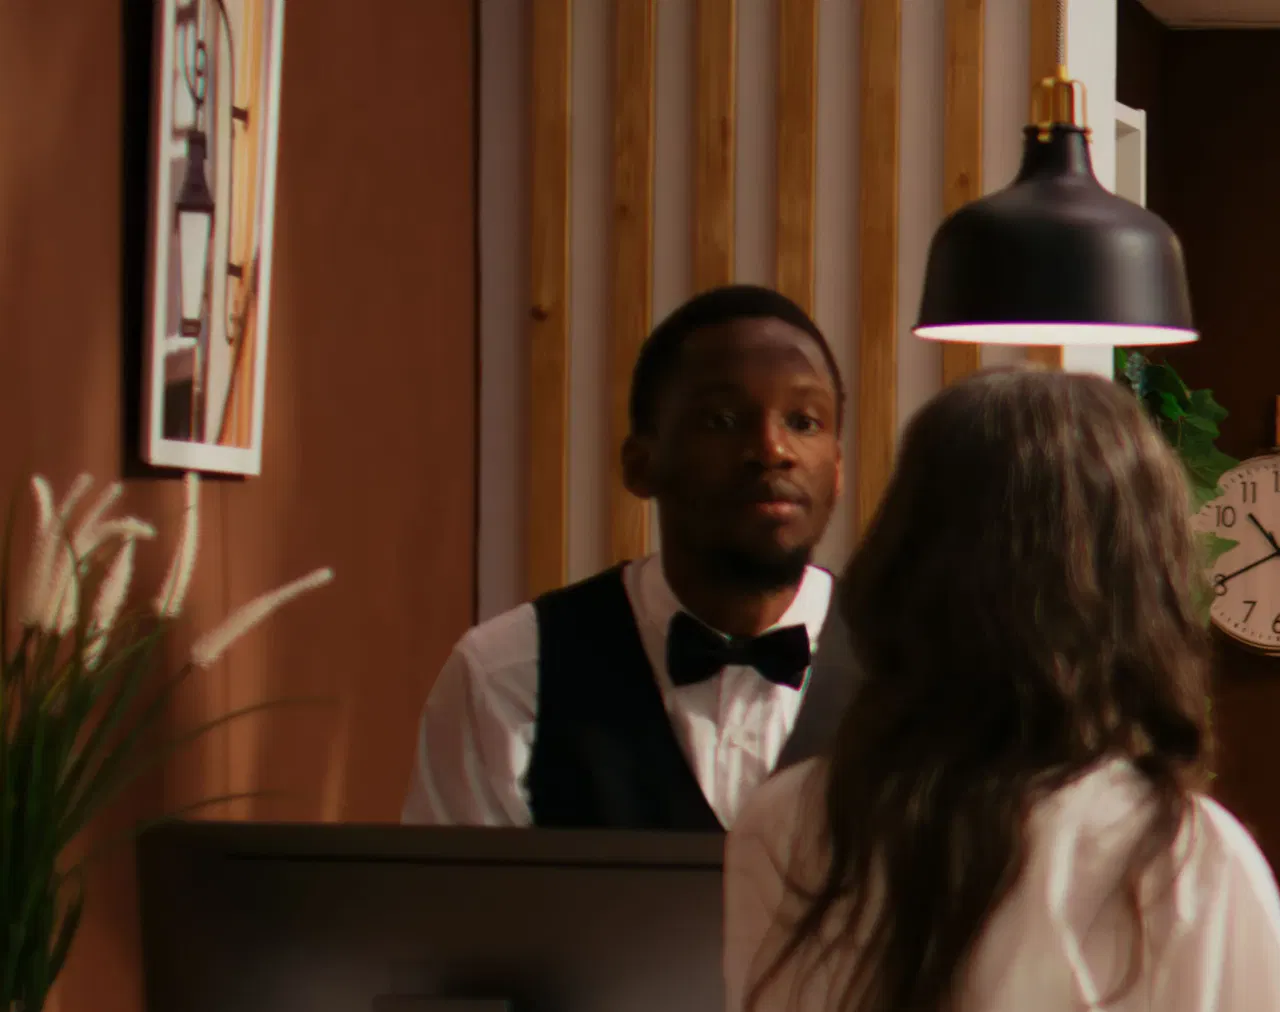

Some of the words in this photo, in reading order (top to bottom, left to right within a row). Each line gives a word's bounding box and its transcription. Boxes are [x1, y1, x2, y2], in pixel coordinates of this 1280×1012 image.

[1240, 482, 1257, 503] 11
[1215, 505, 1236, 528] 10
[1213, 573, 1228, 596] 8
[1243, 600, 1258, 623] 7
